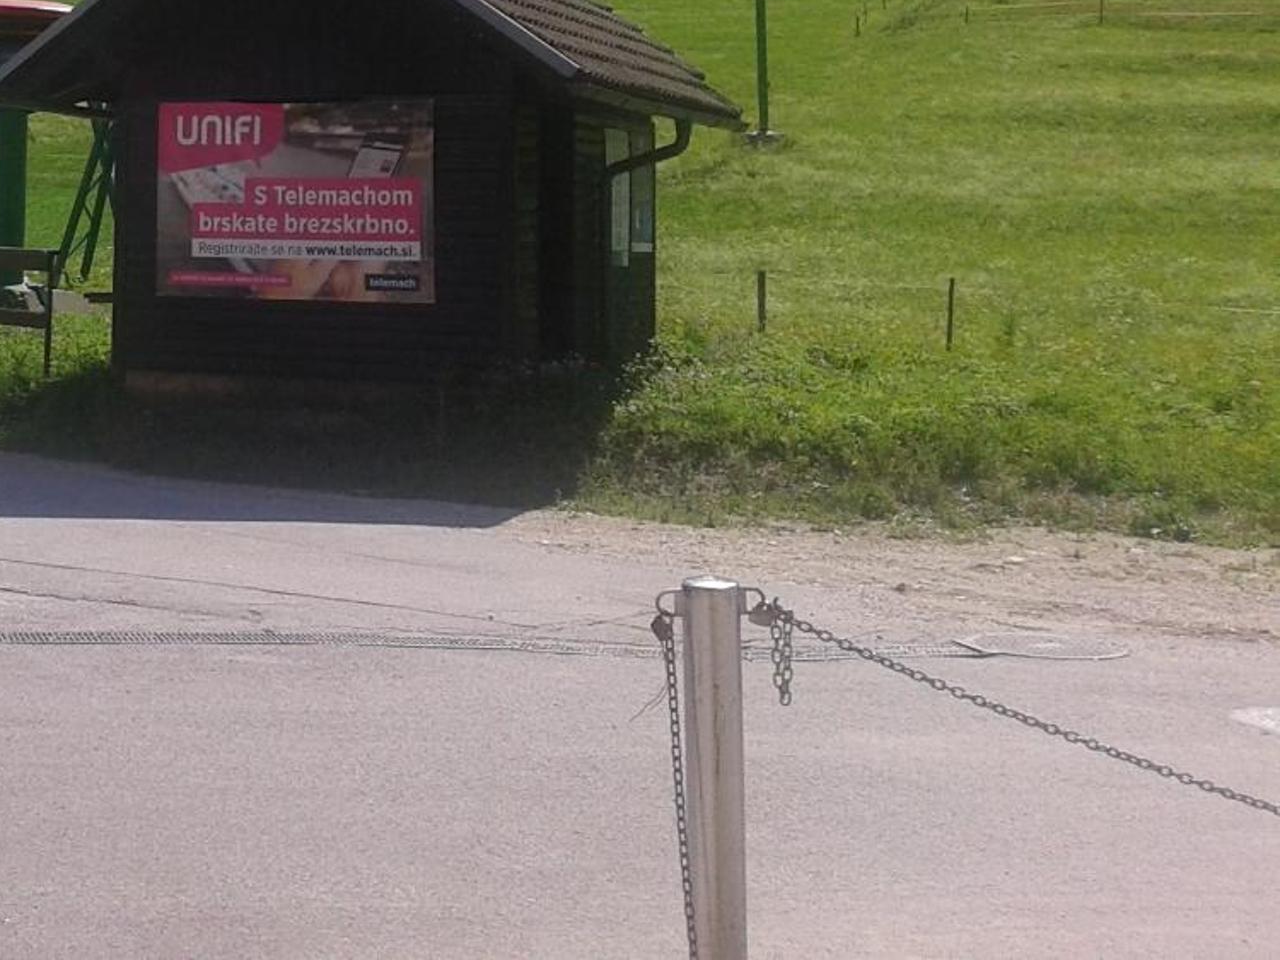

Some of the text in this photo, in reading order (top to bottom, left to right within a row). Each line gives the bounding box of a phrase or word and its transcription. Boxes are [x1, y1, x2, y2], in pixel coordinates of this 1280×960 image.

[176, 115, 260, 146] UNIFI
[254, 185, 413, 207] S Telemachom
[199, 213, 415, 235] brskate brezskrbno.
[269, 245, 284, 255] se
[369, 278, 416, 289] telemach
